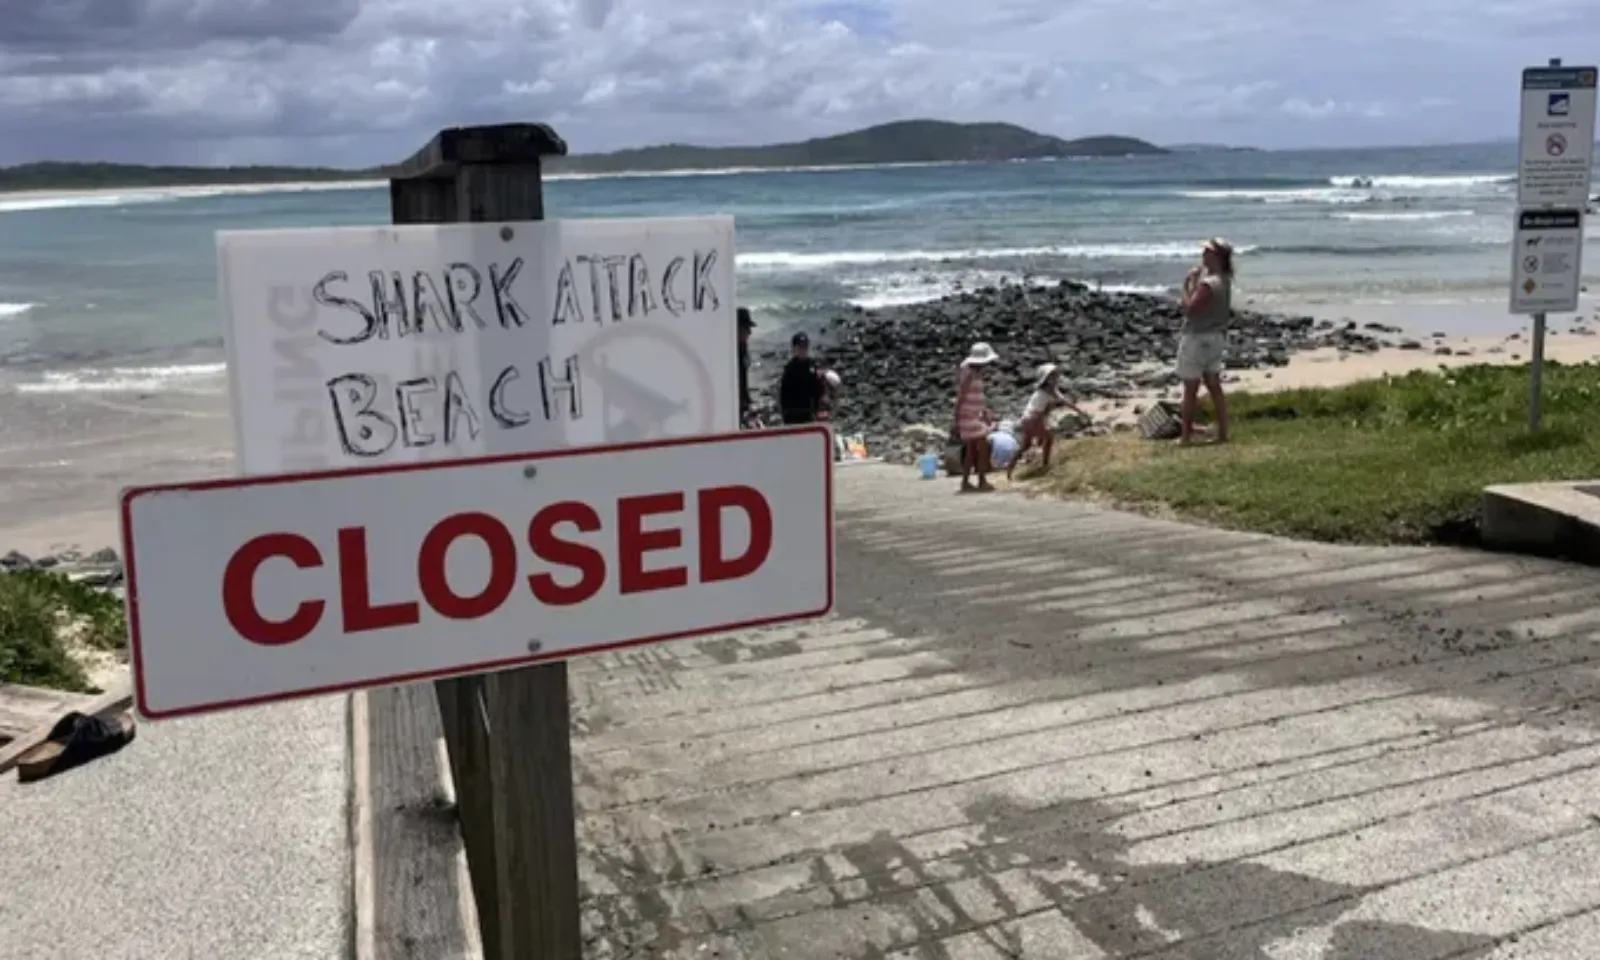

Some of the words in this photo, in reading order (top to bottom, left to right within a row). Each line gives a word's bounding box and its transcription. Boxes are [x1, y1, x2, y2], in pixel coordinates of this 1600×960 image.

[312, 257, 530, 345] SHARK
[552, 249, 721, 326] ATTACK
[327, 353, 583, 458] BEACH
[221, 484, 774, 646] CLOSED
